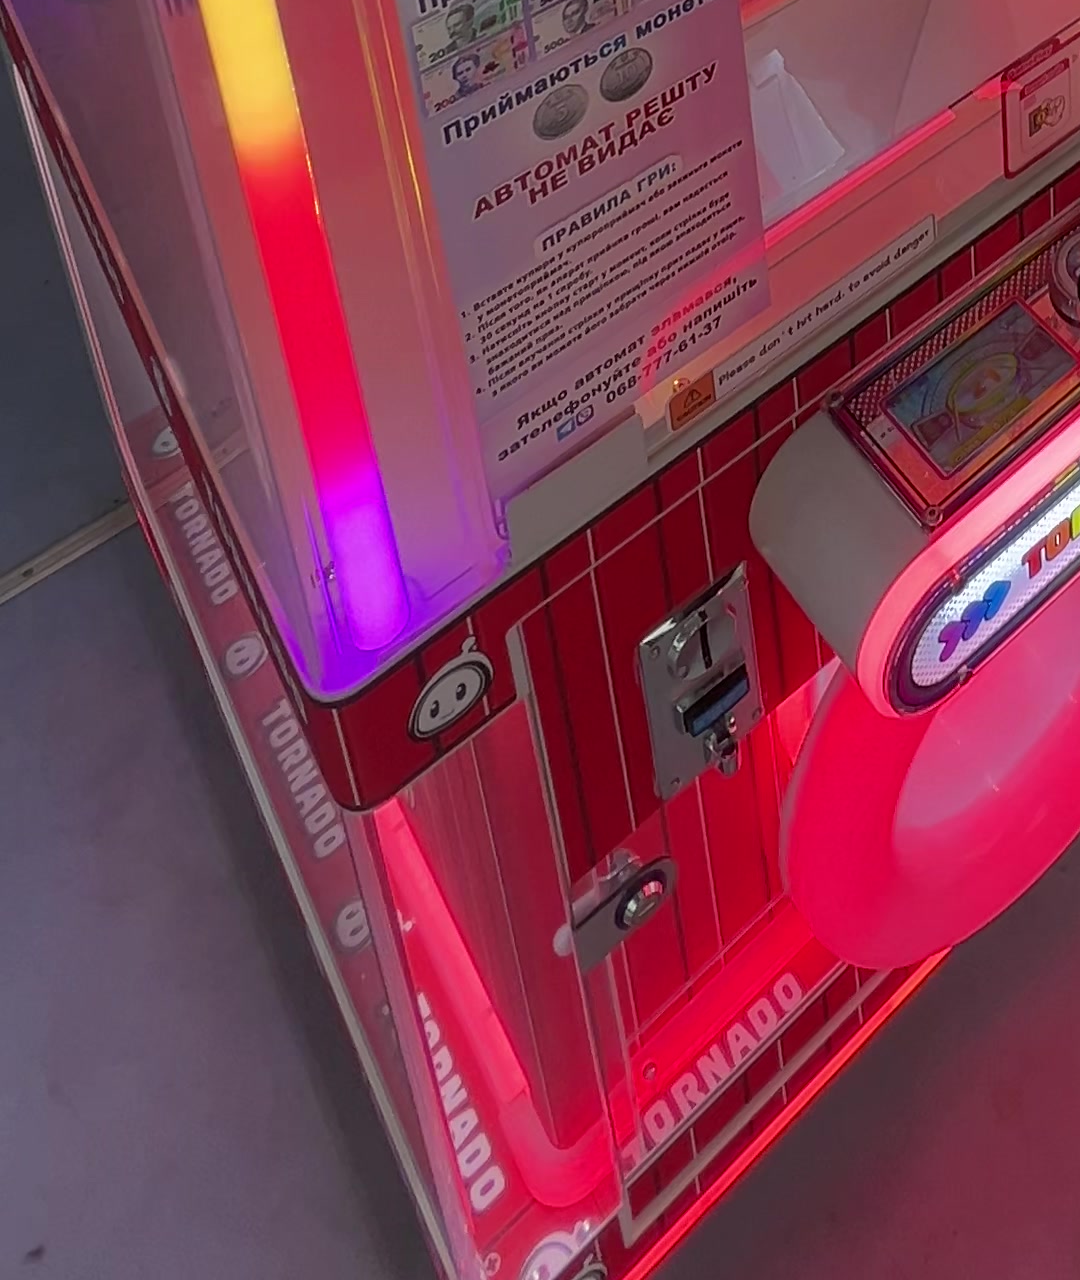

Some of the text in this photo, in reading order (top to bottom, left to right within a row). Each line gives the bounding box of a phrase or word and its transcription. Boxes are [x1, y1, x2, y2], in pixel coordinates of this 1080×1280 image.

[428, 46, 446, 64] 20
[443, 33, 627, 145] Приймаються
[474, 62, 716, 220] АВТОМАТ РЕШТУ
[528, 107, 674, 205] НЕ ВИДАЄ
[542, 162, 677, 252] ПРАВИЛА ГРИ:
[497, 278, 758, 462] зателефонуйте або напишіть
[517, 276, 737, 431] Якщо автомат зламався,
[606, 314, 722, 404] 068-777-61-37
[718, 355, 756, 386] Please
[848, 281, 861, 292] to
[862, 255, 890, 282] avoid
[893, 229, 929, 260] danger
[168, 481, 239, 605] TORNADO
[262, 697, 346, 859] TORNADO
[620, 972, 802, 1169] TORNADO
